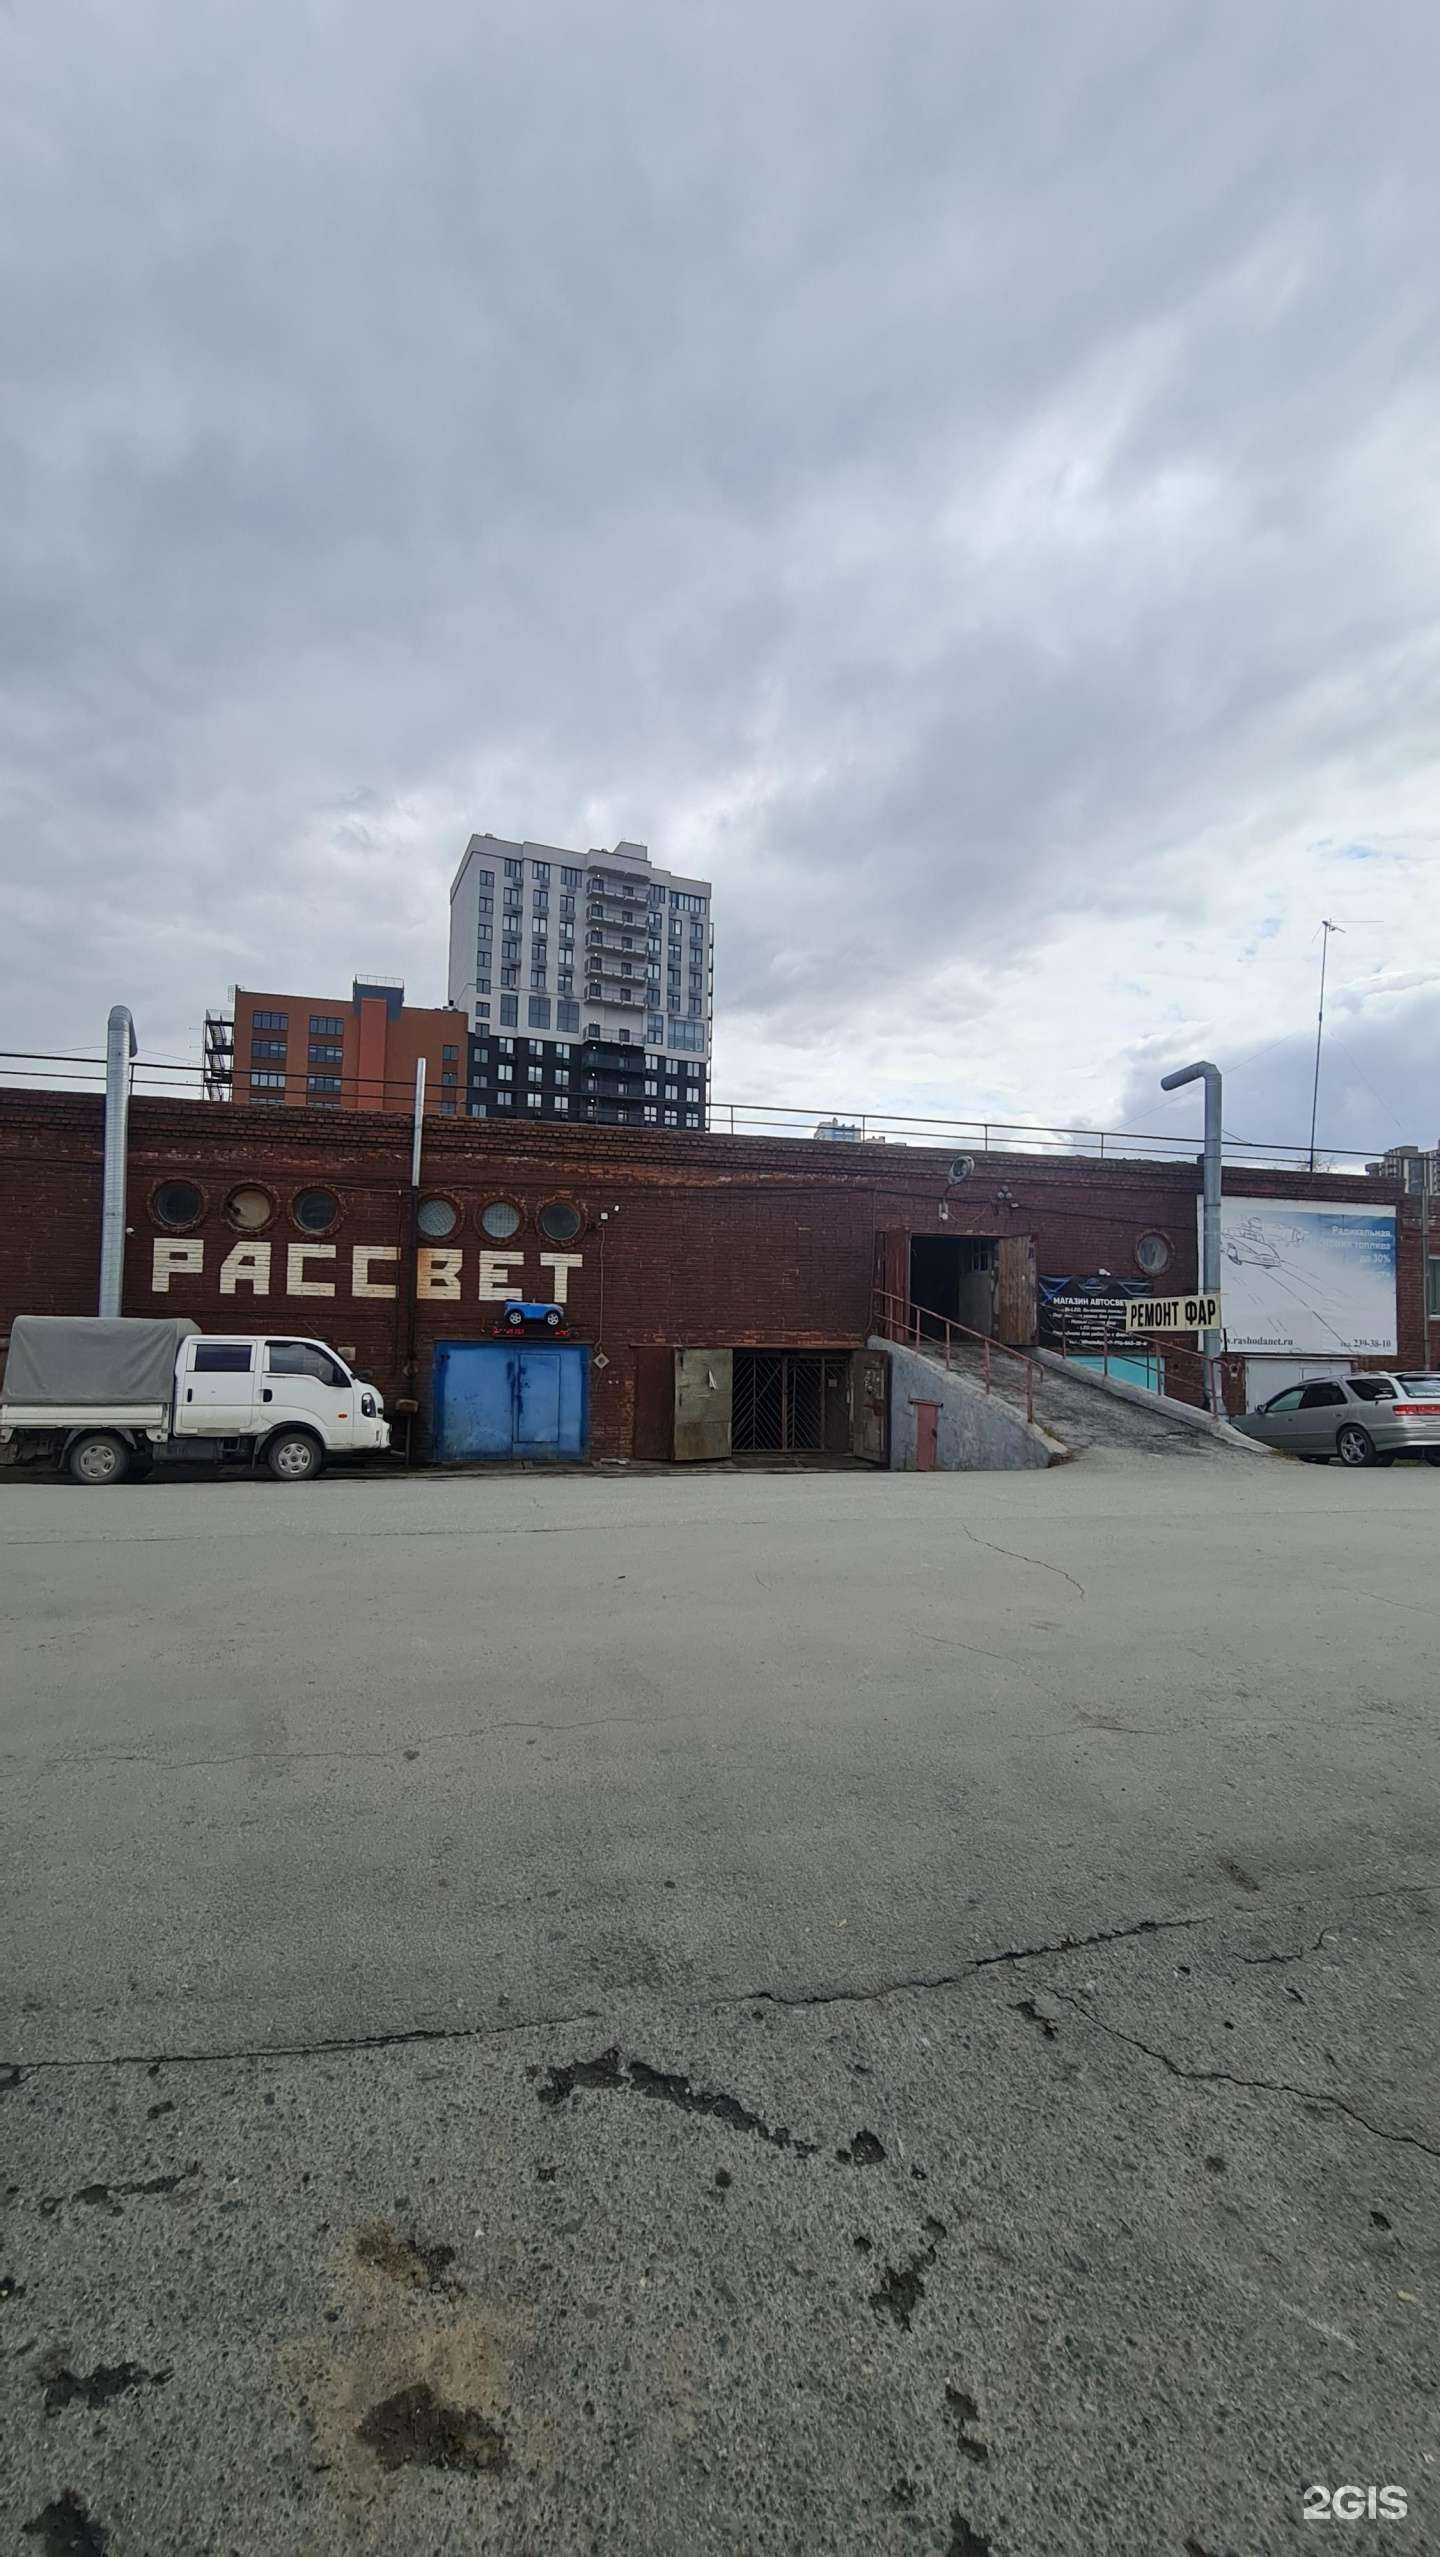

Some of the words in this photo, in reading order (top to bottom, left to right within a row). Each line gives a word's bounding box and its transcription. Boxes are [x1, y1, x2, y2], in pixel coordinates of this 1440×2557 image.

[152, 1237, 583, 1303] РАССВЕТ
[1053, 1297, 1089, 1305] МАГАЗИН
[1130, 1301, 1179, 1327] РЕМОНТ
[1185, 1299, 1216, 1325] ФАР
